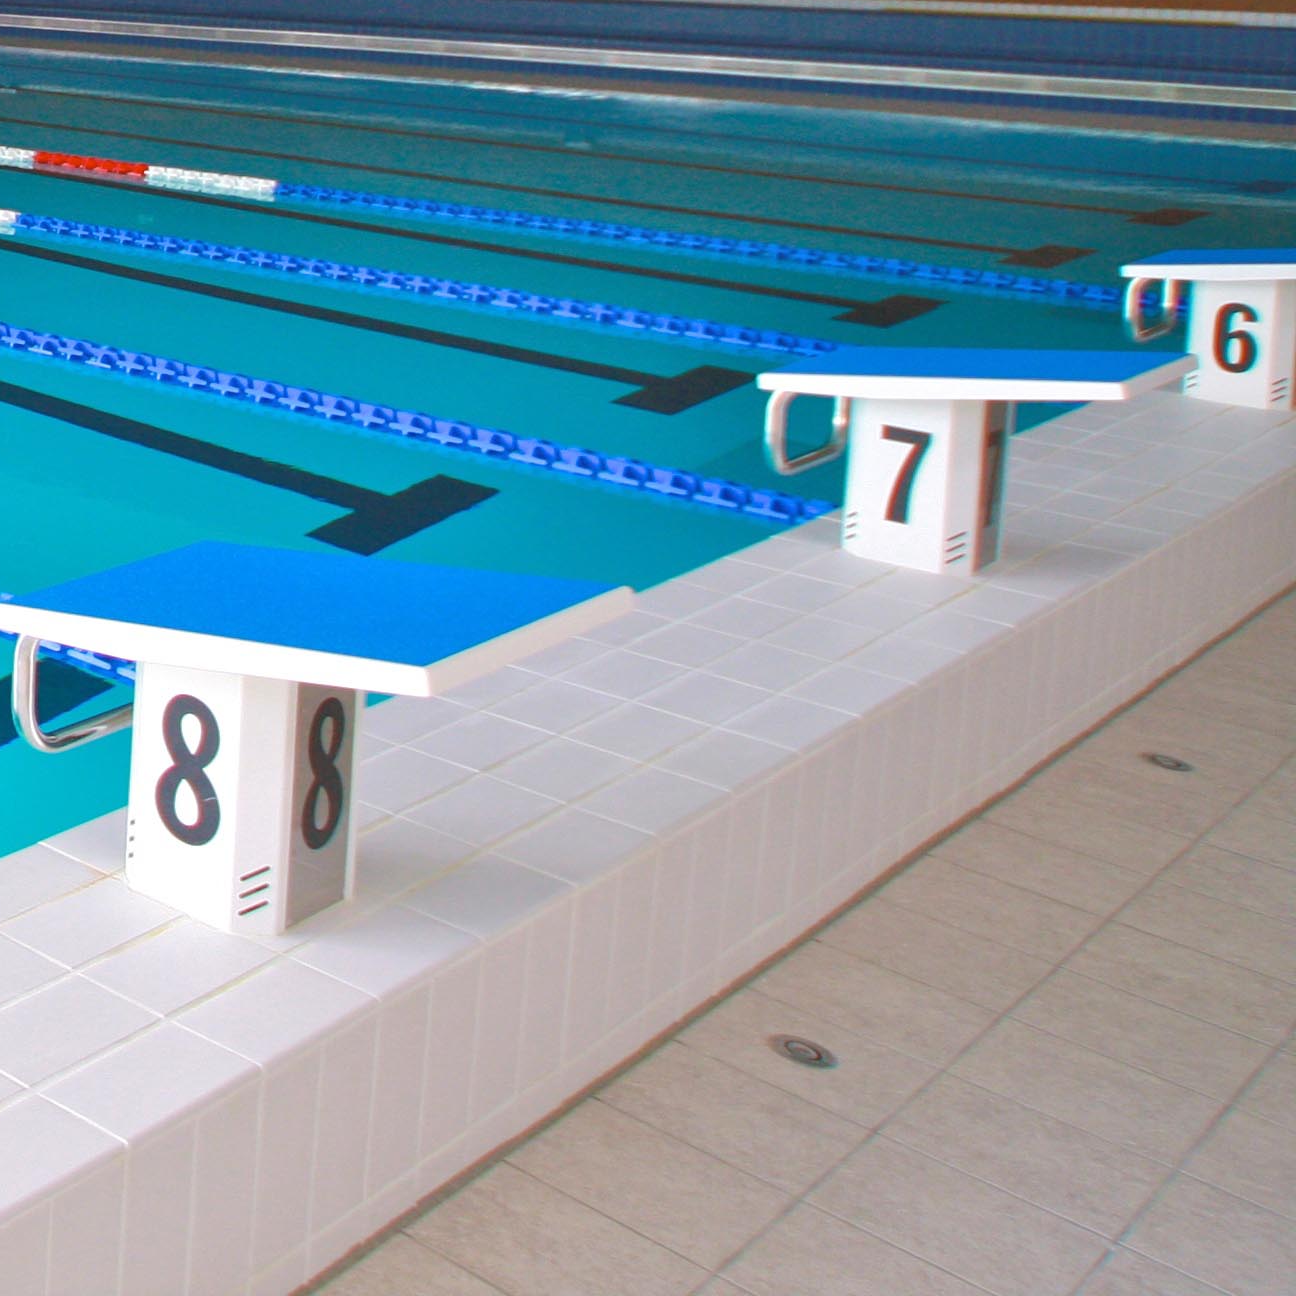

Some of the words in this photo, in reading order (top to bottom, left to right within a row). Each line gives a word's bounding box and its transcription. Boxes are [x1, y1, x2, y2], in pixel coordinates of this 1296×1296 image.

[1213, 302, 1259, 373] 6
[881, 424, 932, 525] 7
[155, 694, 221, 846] 8
[302, 697, 345, 850] 8
